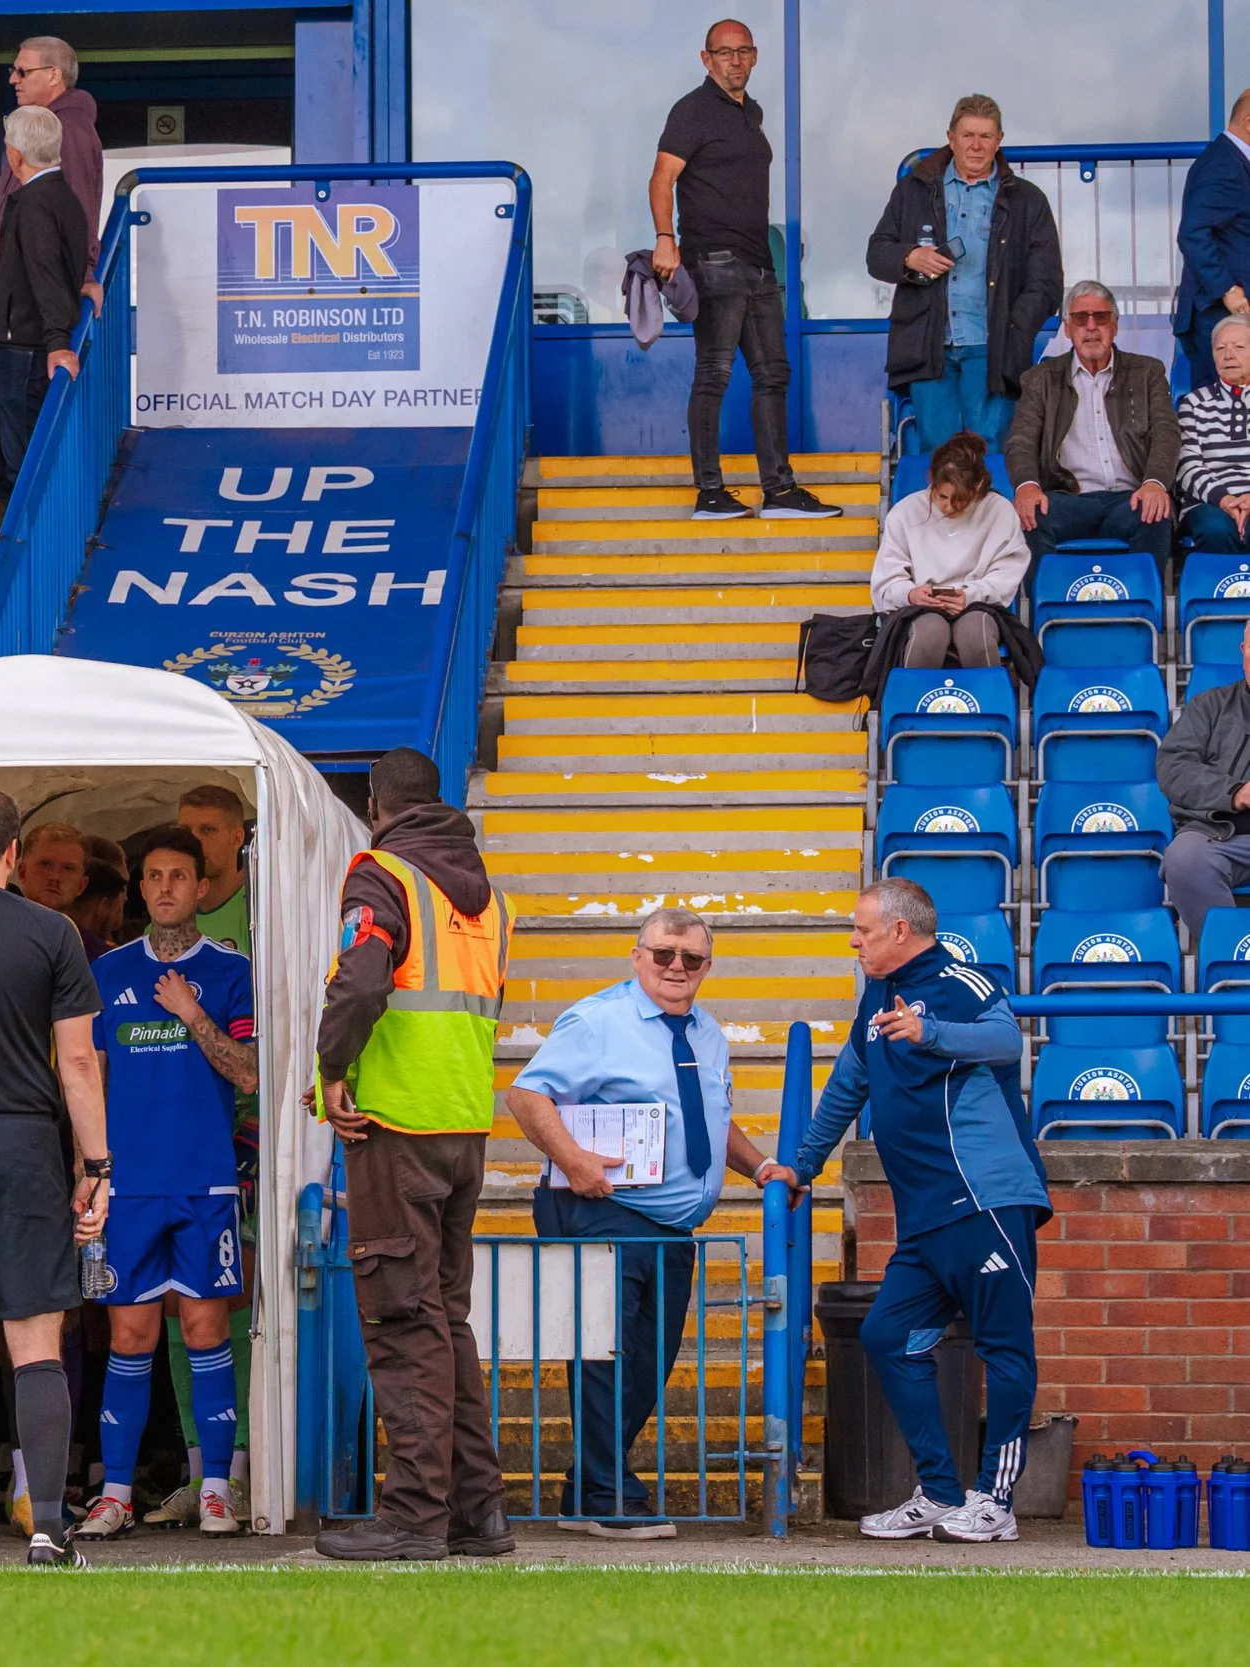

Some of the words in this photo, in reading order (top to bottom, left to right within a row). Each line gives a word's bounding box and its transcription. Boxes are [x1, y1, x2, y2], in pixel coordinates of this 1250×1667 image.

[234, 204, 401, 281] TNR
[234, 309, 266, 328] T.N.
[273, 308, 367, 327] ROBINSON
[373, 307, 405, 325] LTD
[234, 332, 289, 345] Wholesale
[291, 332, 340, 344] Electrical
[343, 331, 405, 343] Distributors
[368, 350, 380, 360] Est
[383, 349, 405, 360] 1923
[136, 393, 237, 411] OFFICIAL
[245, 391, 323, 409] MATCH
[333, 391, 377, 408] DAY
[219, 466, 374, 502] UP
[163, 518, 395, 554] THE
[108, 569, 447, 606] NASH
[210, 631, 265, 639] CURZON
[270, 631, 326, 639] ASHTON
[918, 809, 944, 830] CURZON
[948, 809, 975, 830] ASHTON
[1076, 806, 1103, 827] CURZON
[1107, 806, 1134, 828] ASHTON
[943, 935, 970, 955] ASHTON
[1076, 937, 1104, 961] CURZON
[1106, 937, 1135, 957] ASHTON
[130, 1023, 187, 1041] Pinnacle
[130, 1045, 160, 1053] Electrical
[161, 1043, 188, 1052] Supplies
[1074, 1070, 1104, 1092] CURZON
[1108, 1070, 1136, 1095] ASHTON
[219, 1228, 235, 1268] 8
